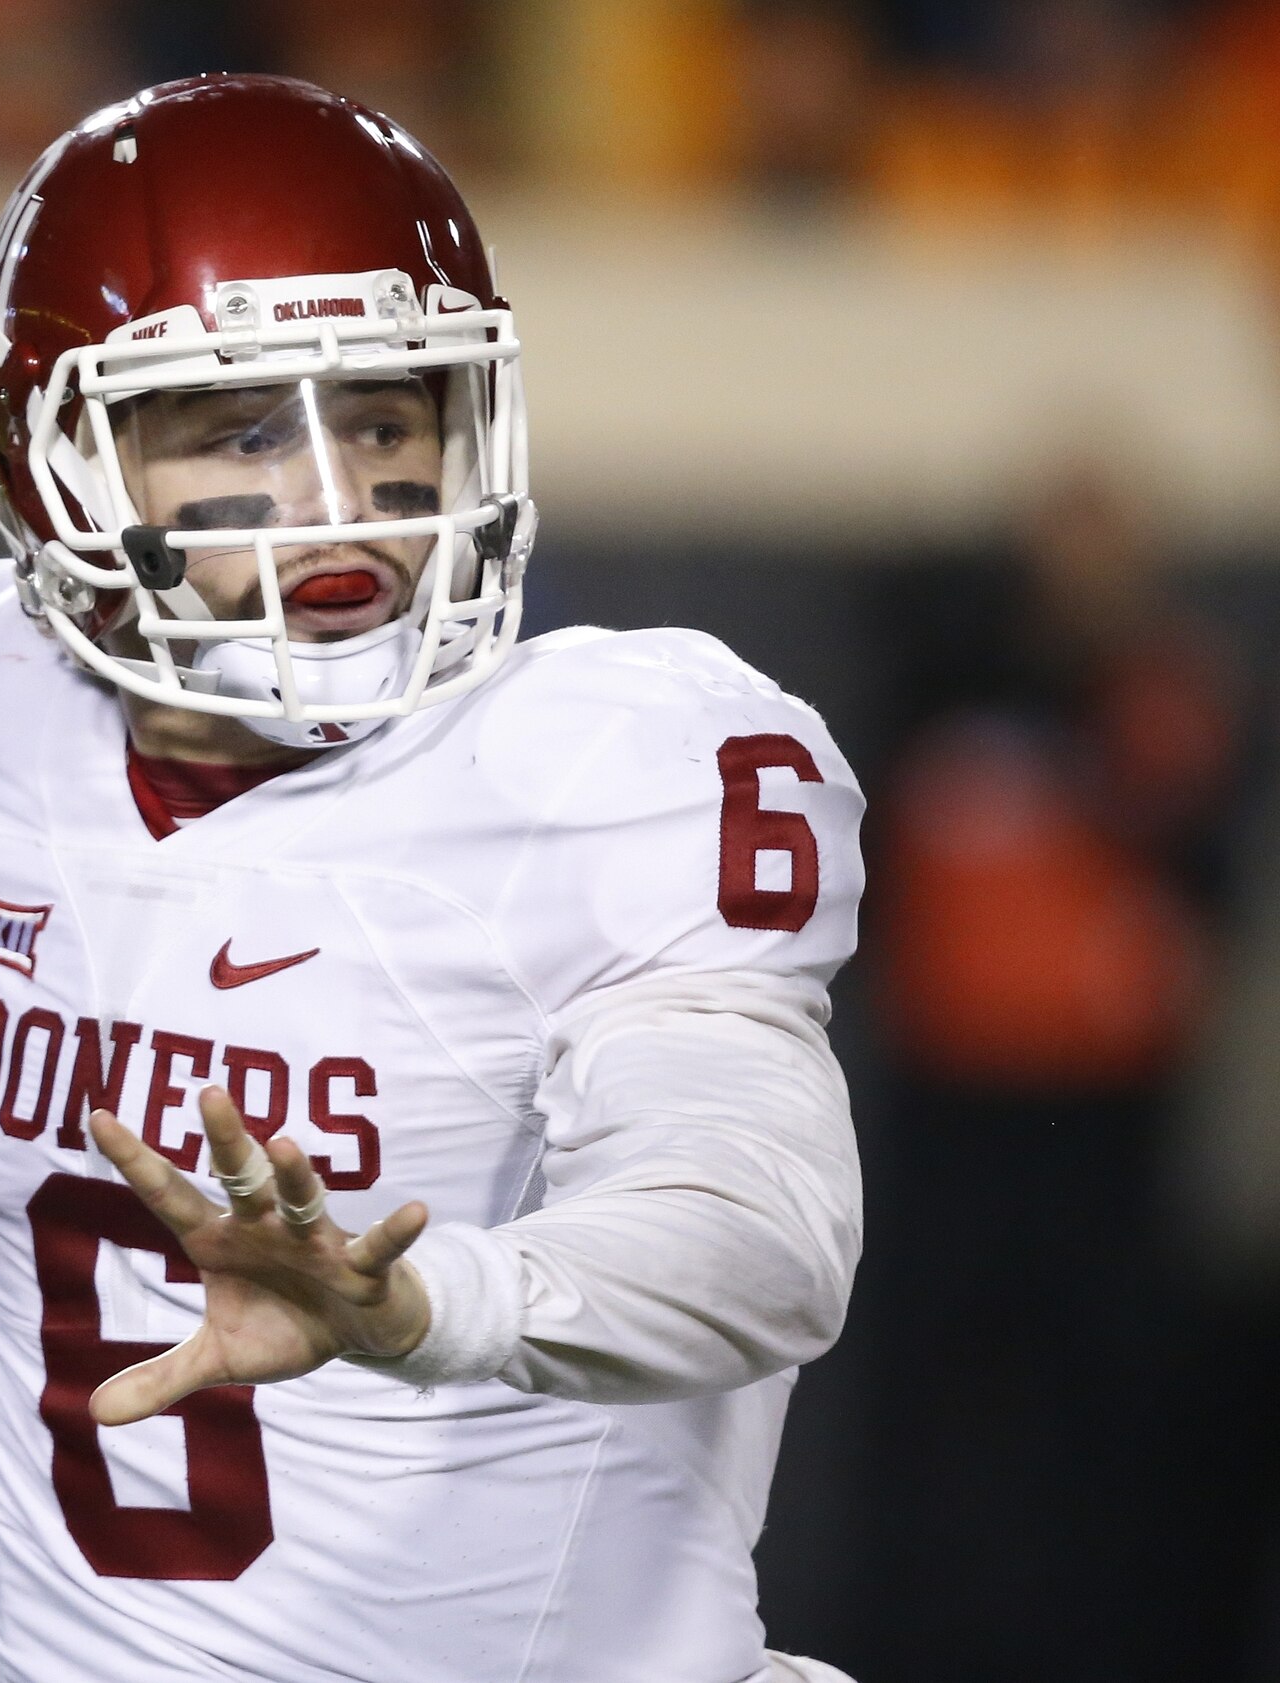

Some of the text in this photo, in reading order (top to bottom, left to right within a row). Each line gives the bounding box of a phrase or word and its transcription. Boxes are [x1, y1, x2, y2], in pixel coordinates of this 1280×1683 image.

[273, 298, 366, 323] OKLAHOMA
[716, 733, 824, 933] 6
[26, 1171, 274, 1581] 6
